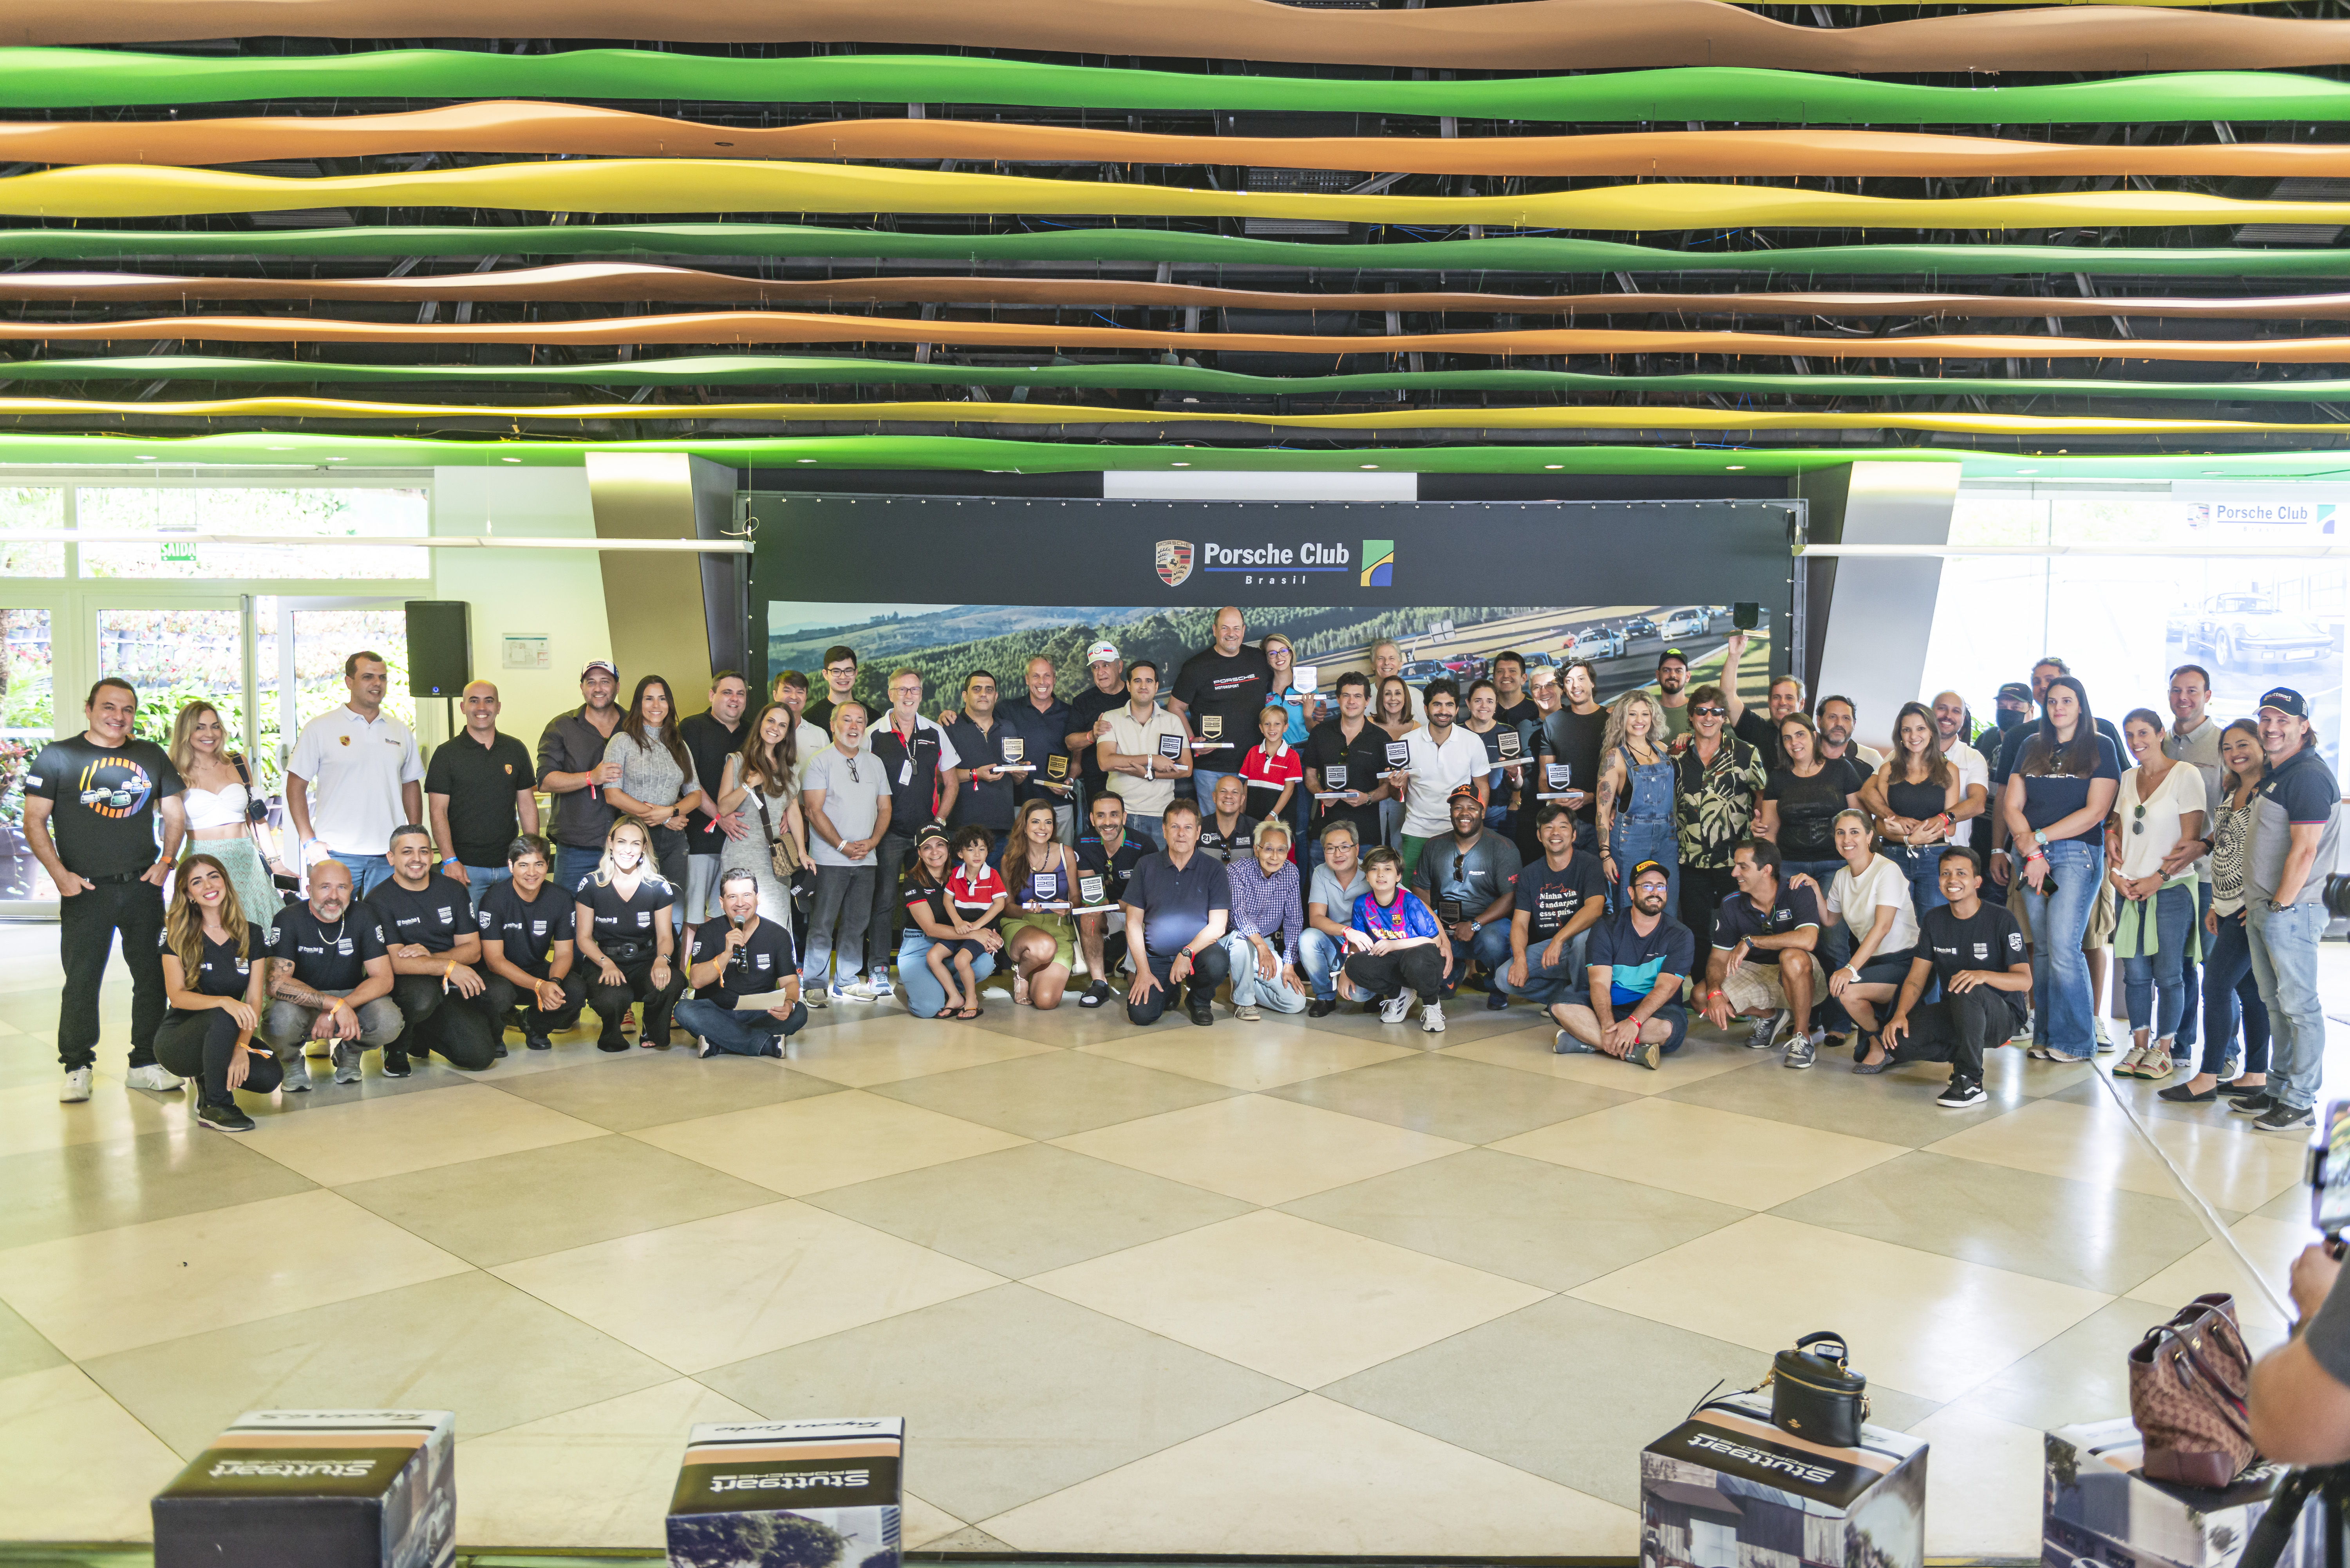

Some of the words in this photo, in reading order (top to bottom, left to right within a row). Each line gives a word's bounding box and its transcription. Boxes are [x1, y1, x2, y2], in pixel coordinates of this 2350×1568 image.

[2217, 505, 2272, 519] Porsche
[2278, 506, 2307, 520] Club
[1205, 543, 1293, 564] Porsche
[1300, 543, 1349, 564] Club
[1246, 576, 1305, 584] Brasil
[1213, 674, 1255, 685] PORSCHE
[1687, 1435, 1833, 1483] Stuttgart
[1719, 1438, 1813, 1471] PORSCHE
[209, 1464, 375, 1477] Stuttgart
[738, 1471, 844, 1479] PORSCHE
[710, 1474, 870, 1492] Stuttgart
